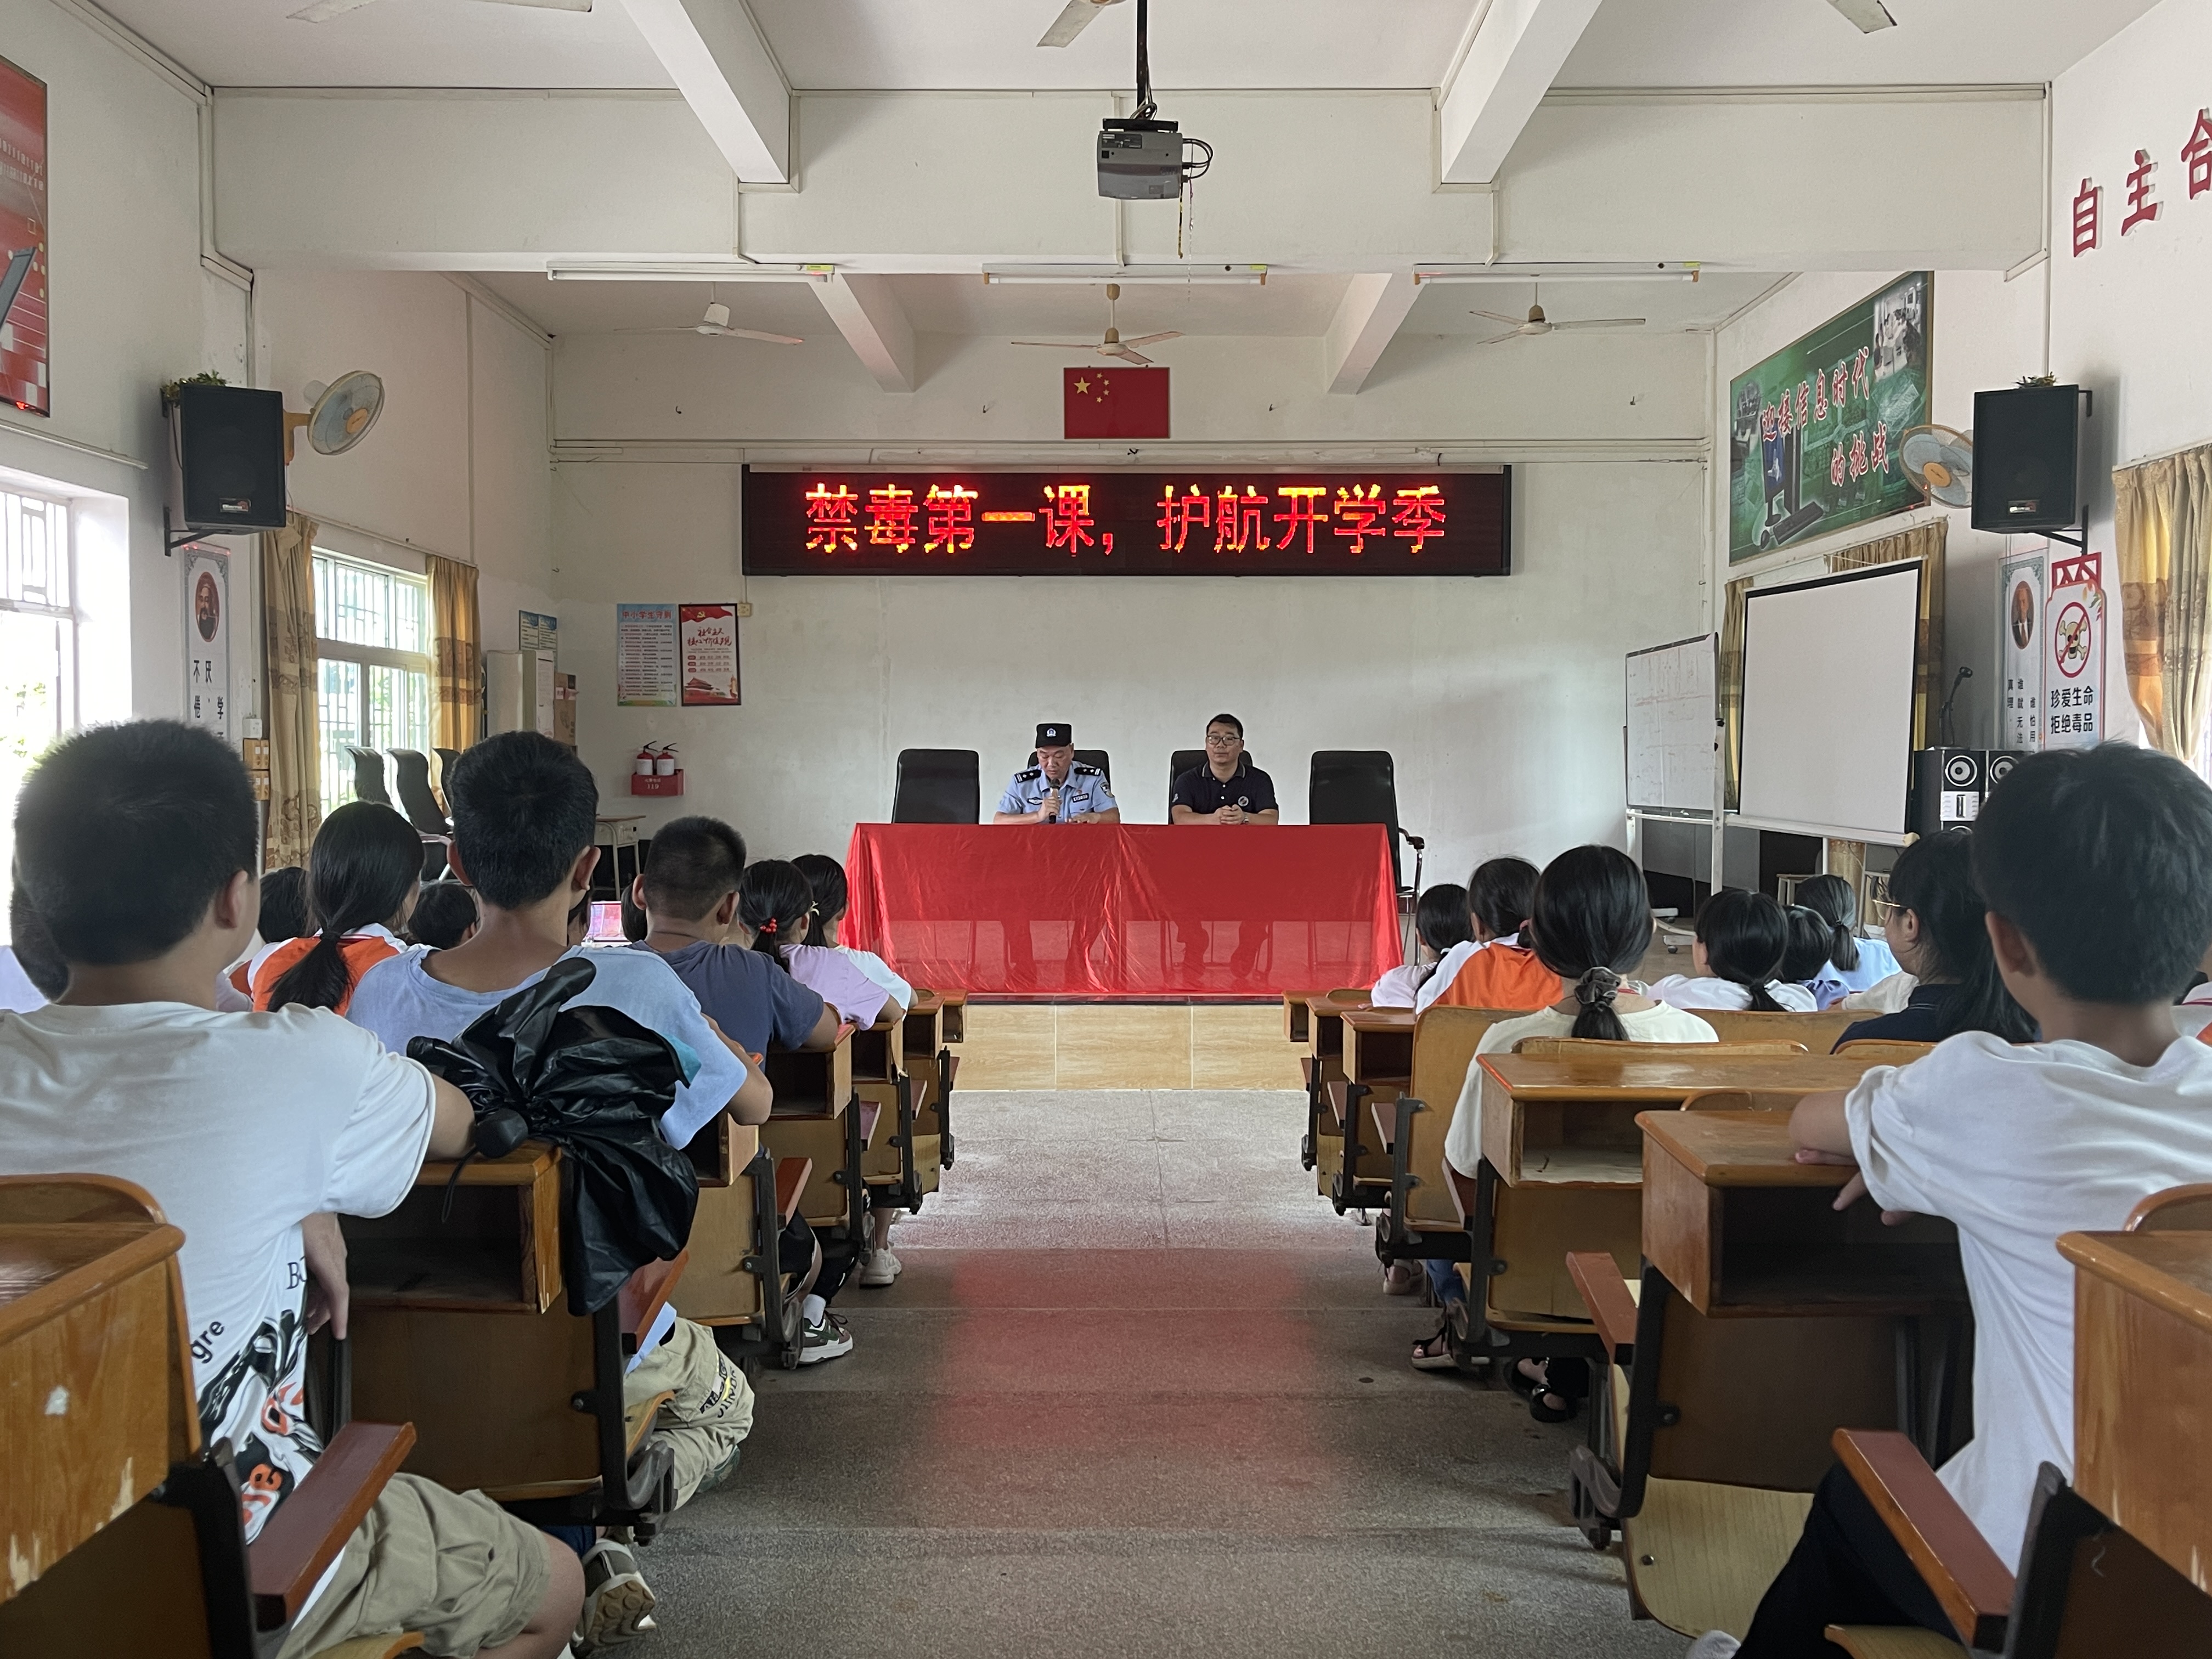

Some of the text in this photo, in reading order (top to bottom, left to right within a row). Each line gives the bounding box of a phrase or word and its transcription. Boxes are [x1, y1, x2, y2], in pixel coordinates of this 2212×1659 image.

[1762, 346, 1869, 442] 迎接信息时代
[1830, 421, 1889, 487] 的挑战
[2051, 686, 2094, 708] 珍爱生命
[2051, 713, 2094, 734] 拒绝毒品
